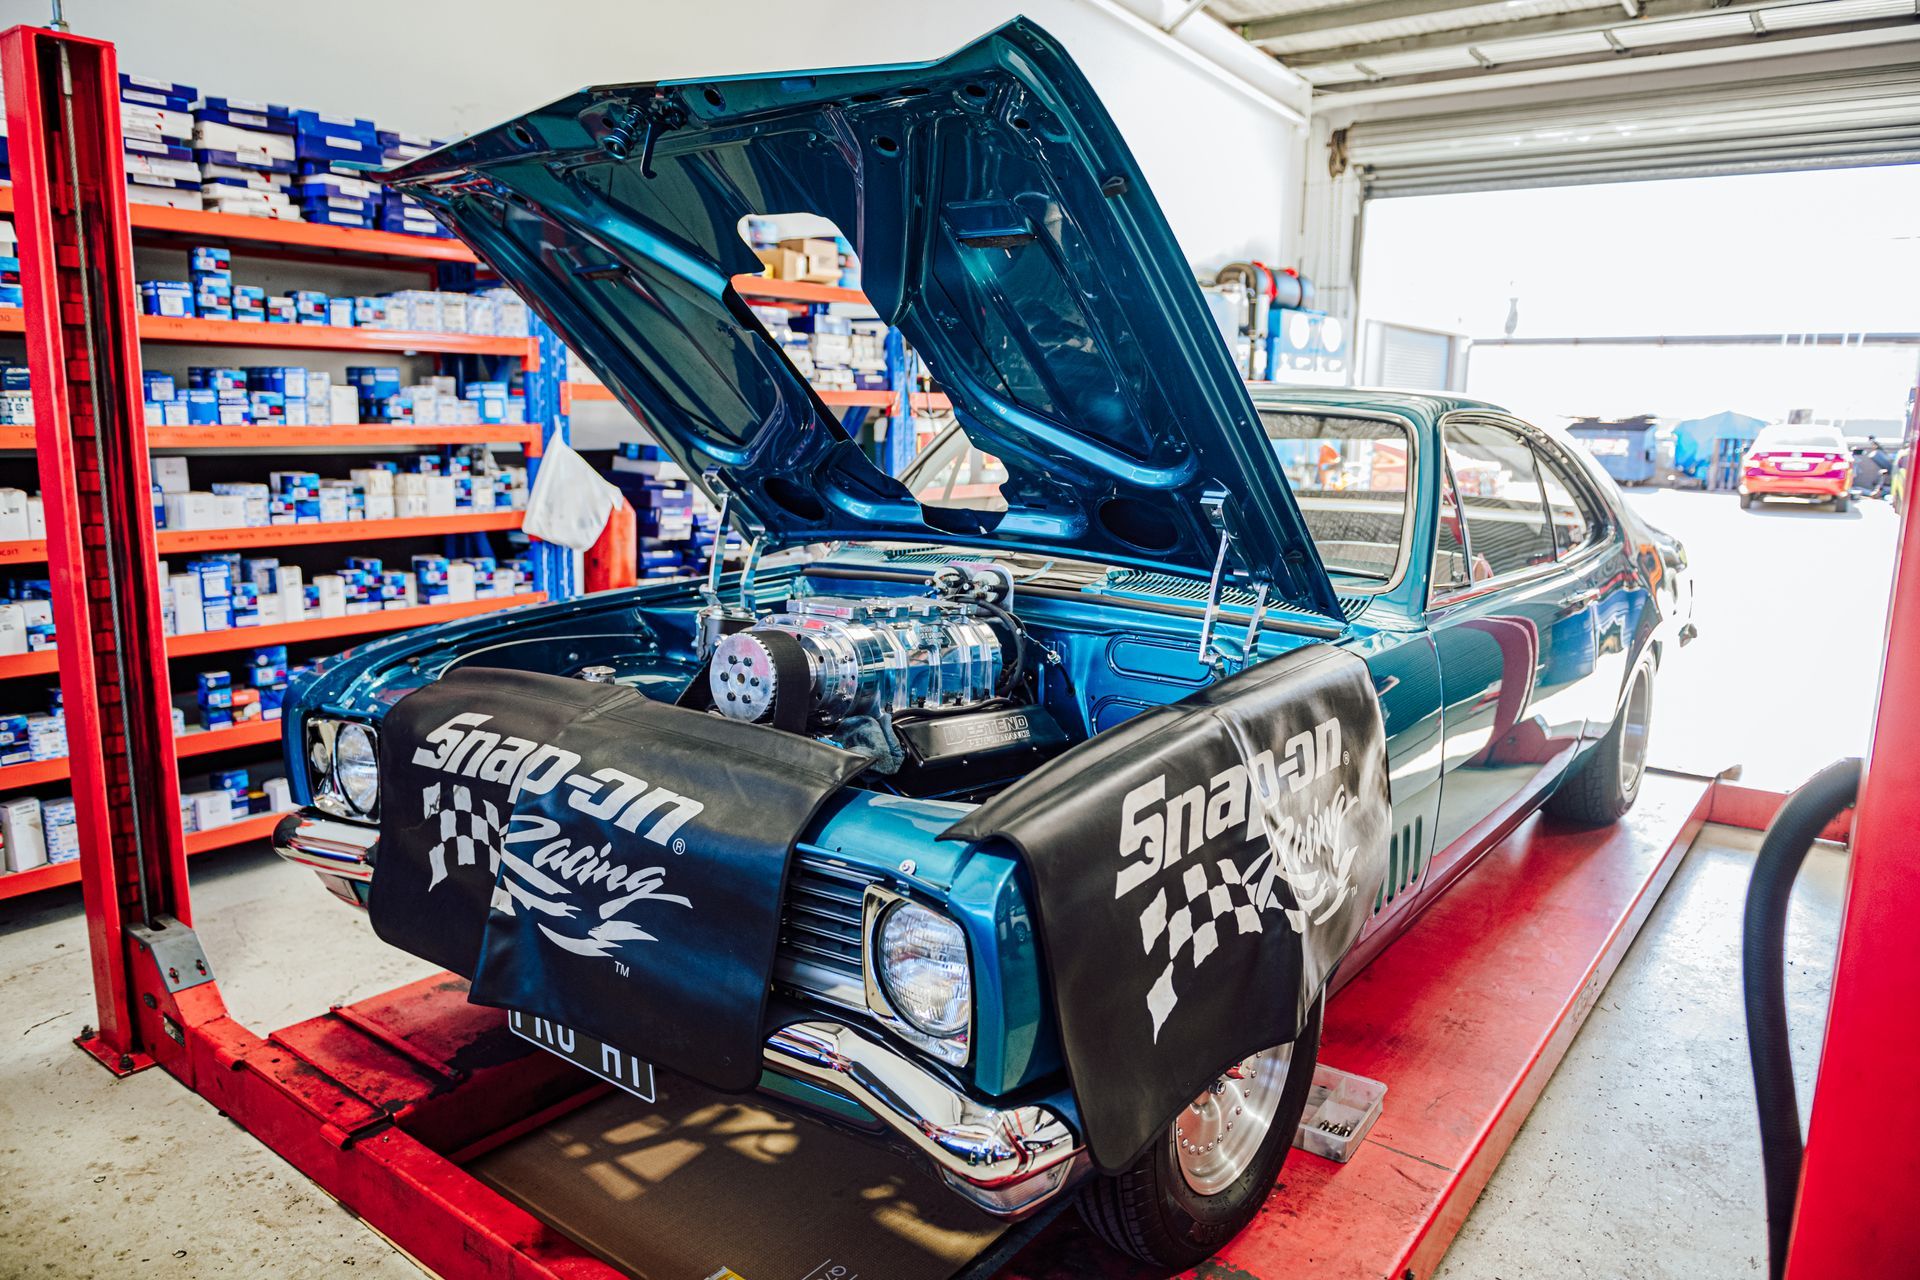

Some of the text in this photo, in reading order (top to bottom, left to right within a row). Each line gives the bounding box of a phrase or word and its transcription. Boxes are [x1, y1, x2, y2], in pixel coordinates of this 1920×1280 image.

[412, 712, 704, 846] Snap-on
[499, 814, 694, 920] Racing
[614, 960, 630, 978] TM
